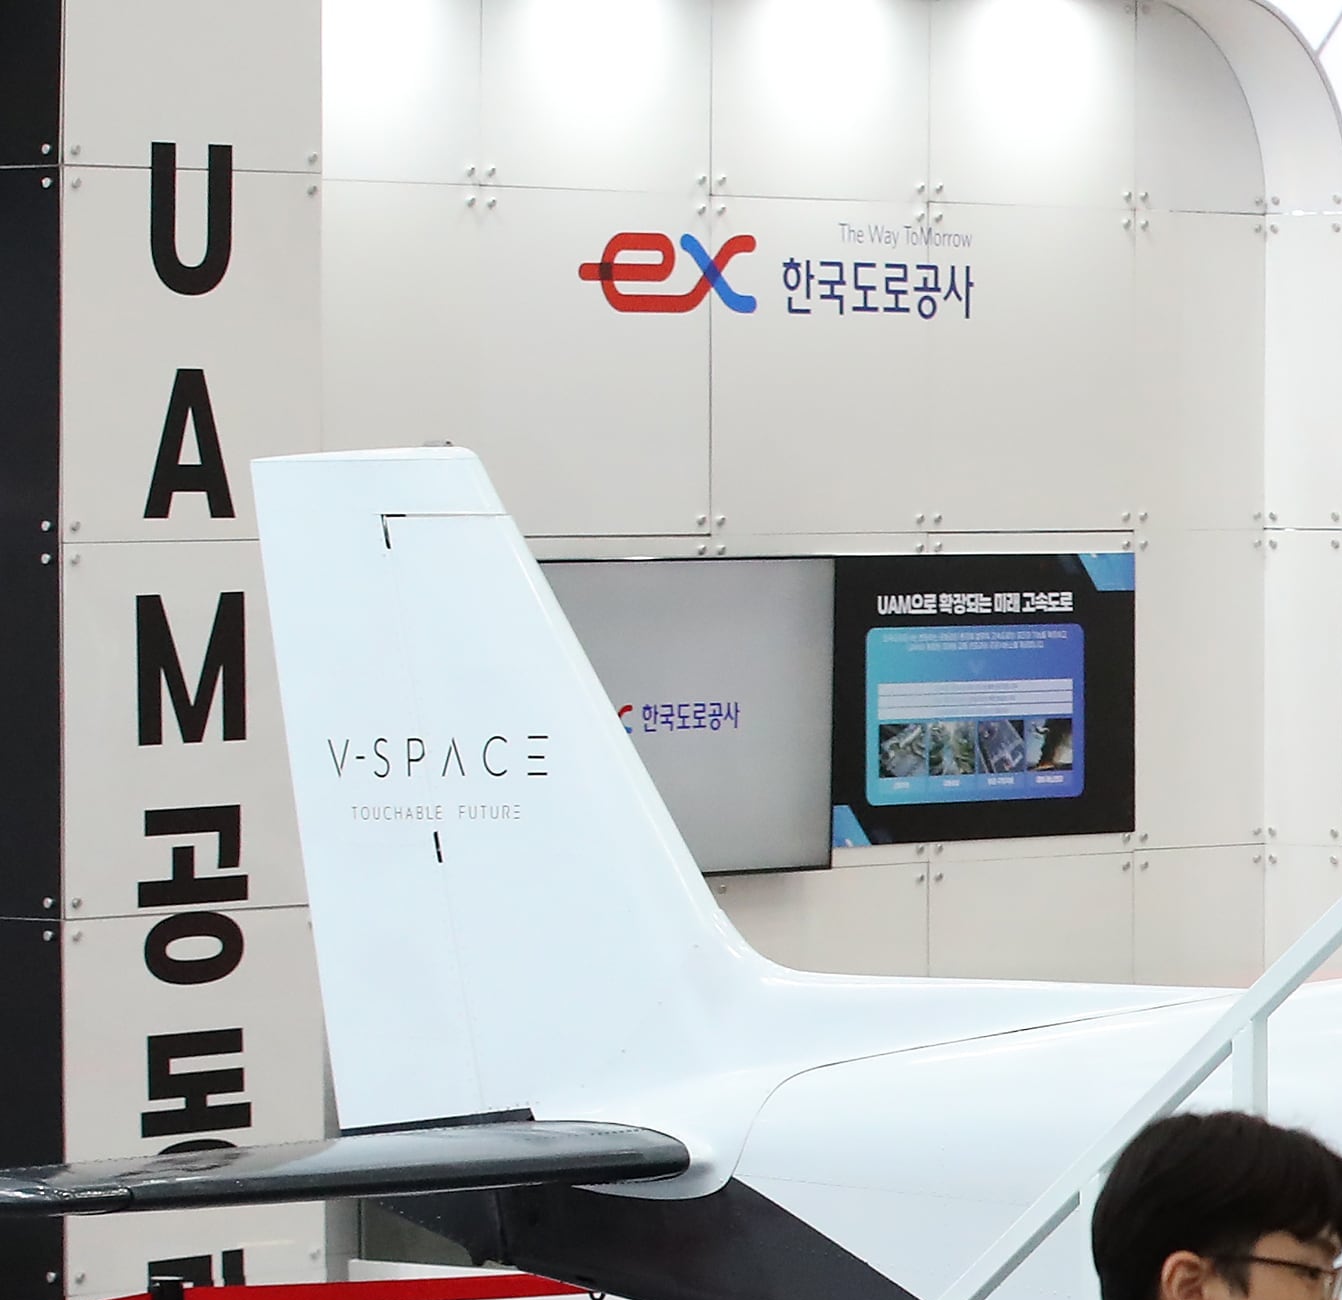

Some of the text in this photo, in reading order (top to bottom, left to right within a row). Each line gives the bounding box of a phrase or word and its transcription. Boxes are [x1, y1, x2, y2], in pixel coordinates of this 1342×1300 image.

[838, 223, 865, 244] The
[868, 224, 900, 249] Way
[578, 232, 757, 314] ex
[782, 257, 975, 320] 한국도로공사
[877, 591, 1074, 615] UAM으로 확장되는 미래 고속도로
[642, 702, 741, 732] 한국도로공사
[327, 735, 549, 778] V-SPACE
[351, 804, 521, 820] TOUCHABLE FUTURE
